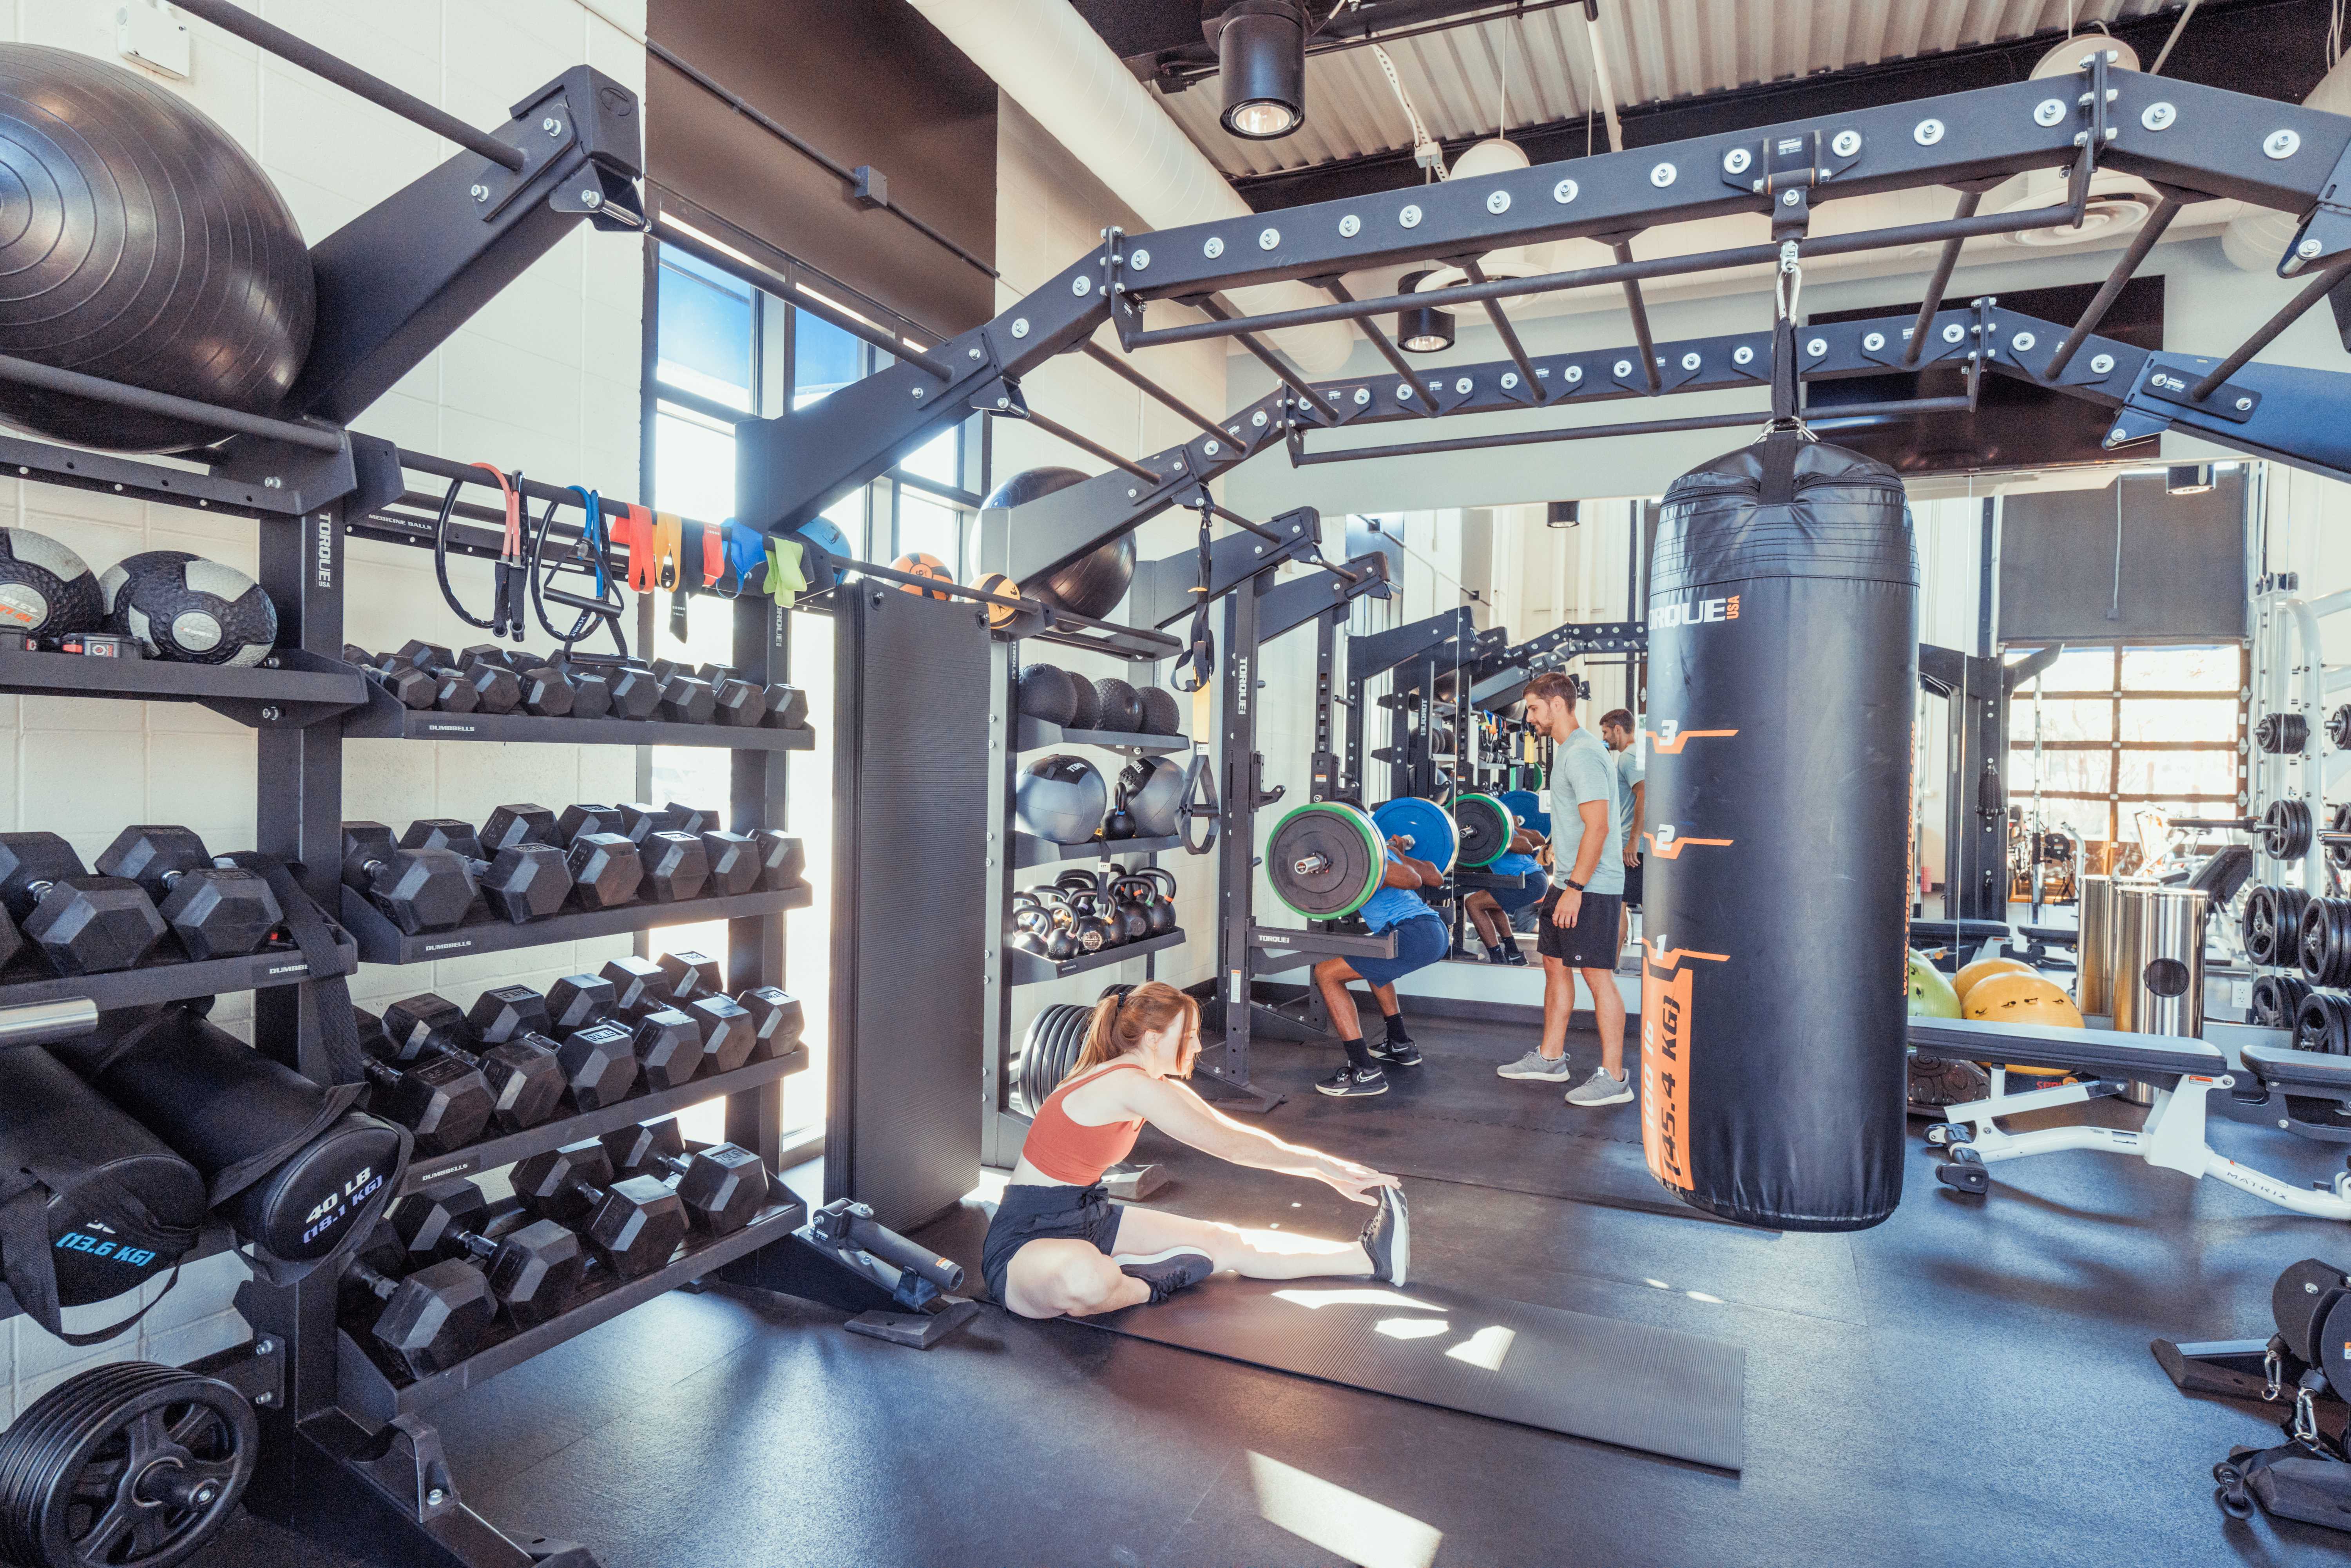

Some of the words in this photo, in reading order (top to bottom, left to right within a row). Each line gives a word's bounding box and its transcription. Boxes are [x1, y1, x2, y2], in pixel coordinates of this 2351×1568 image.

[369, 514, 406, 525] MEDICINE
[408, 521, 432, 530] BALLS
[319, 513, 331, 581] TORQUE
[1648, 598, 1726, 630] ORQUE
[1727, 595, 1740, 619] USA
[1238, 657, 1248, 710] TORQUE
[1659, 720, 1678, 746] 3
[1656, 824, 1675, 851] 2
[426, 941, 471, 951] DUMBBELLS
[1656, 934, 1666, 959] 1
[1661, 996, 1680, 1061] KG)
[1645, 1063, 1655, 1130] 100
[1661, 1071, 1680, 1176] (45.4
[422, 1163, 468, 1181] DUMBBELLS
[716, 1150, 742, 1162] 75LB
[306, 1193, 337, 1223] 40
[345, 1167, 370, 1196] LB
[2227, 1171, 2287, 1201] MATRIX
[304, 1204, 345, 1243] (18.1
[353, 1175, 382, 1206] KG)
[56, 1232, 117, 1257] (13.6
[113, 1246, 156, 1266] KG)
